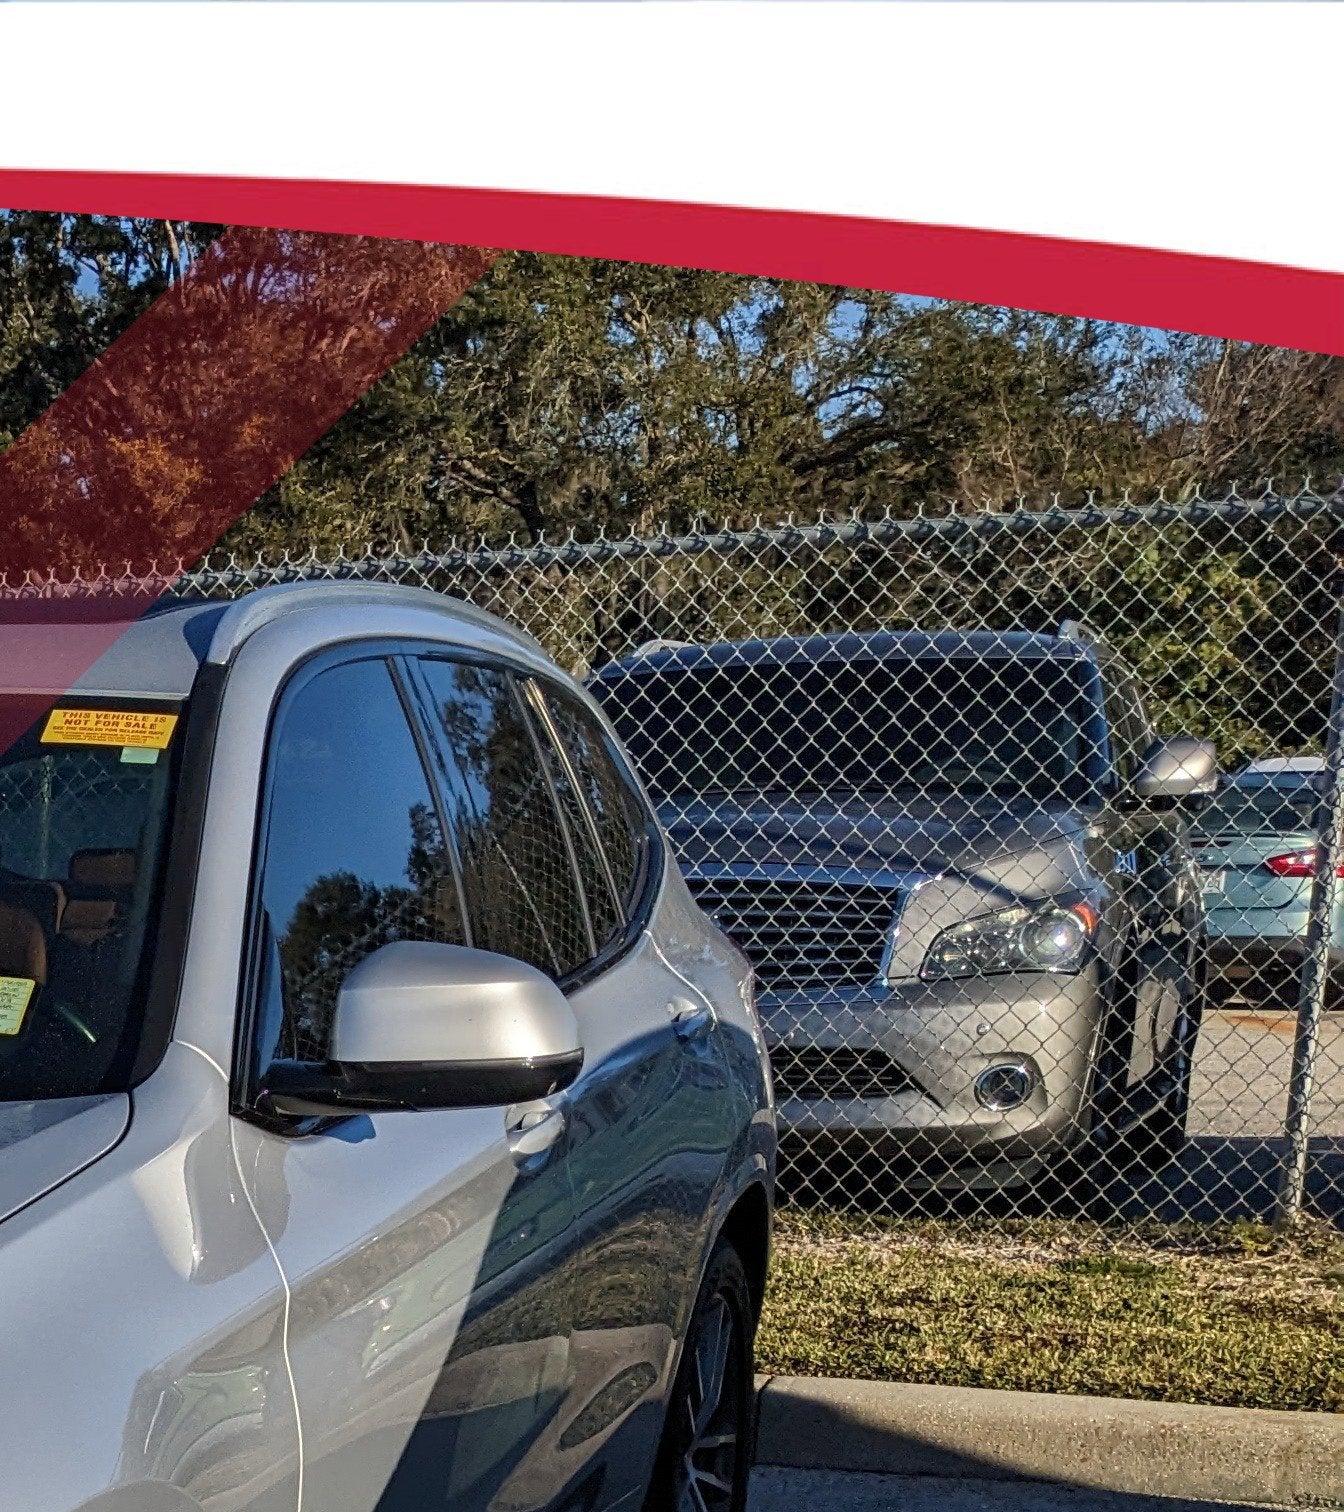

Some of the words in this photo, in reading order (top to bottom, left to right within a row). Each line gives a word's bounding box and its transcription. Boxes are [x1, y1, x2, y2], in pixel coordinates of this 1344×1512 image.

[63, 711, 91, 719] THIS
[95, 713, 149, 722] VEHICLE
[95, 720, 119, 728] FOR
[124, 721, 157, 730] SALE
